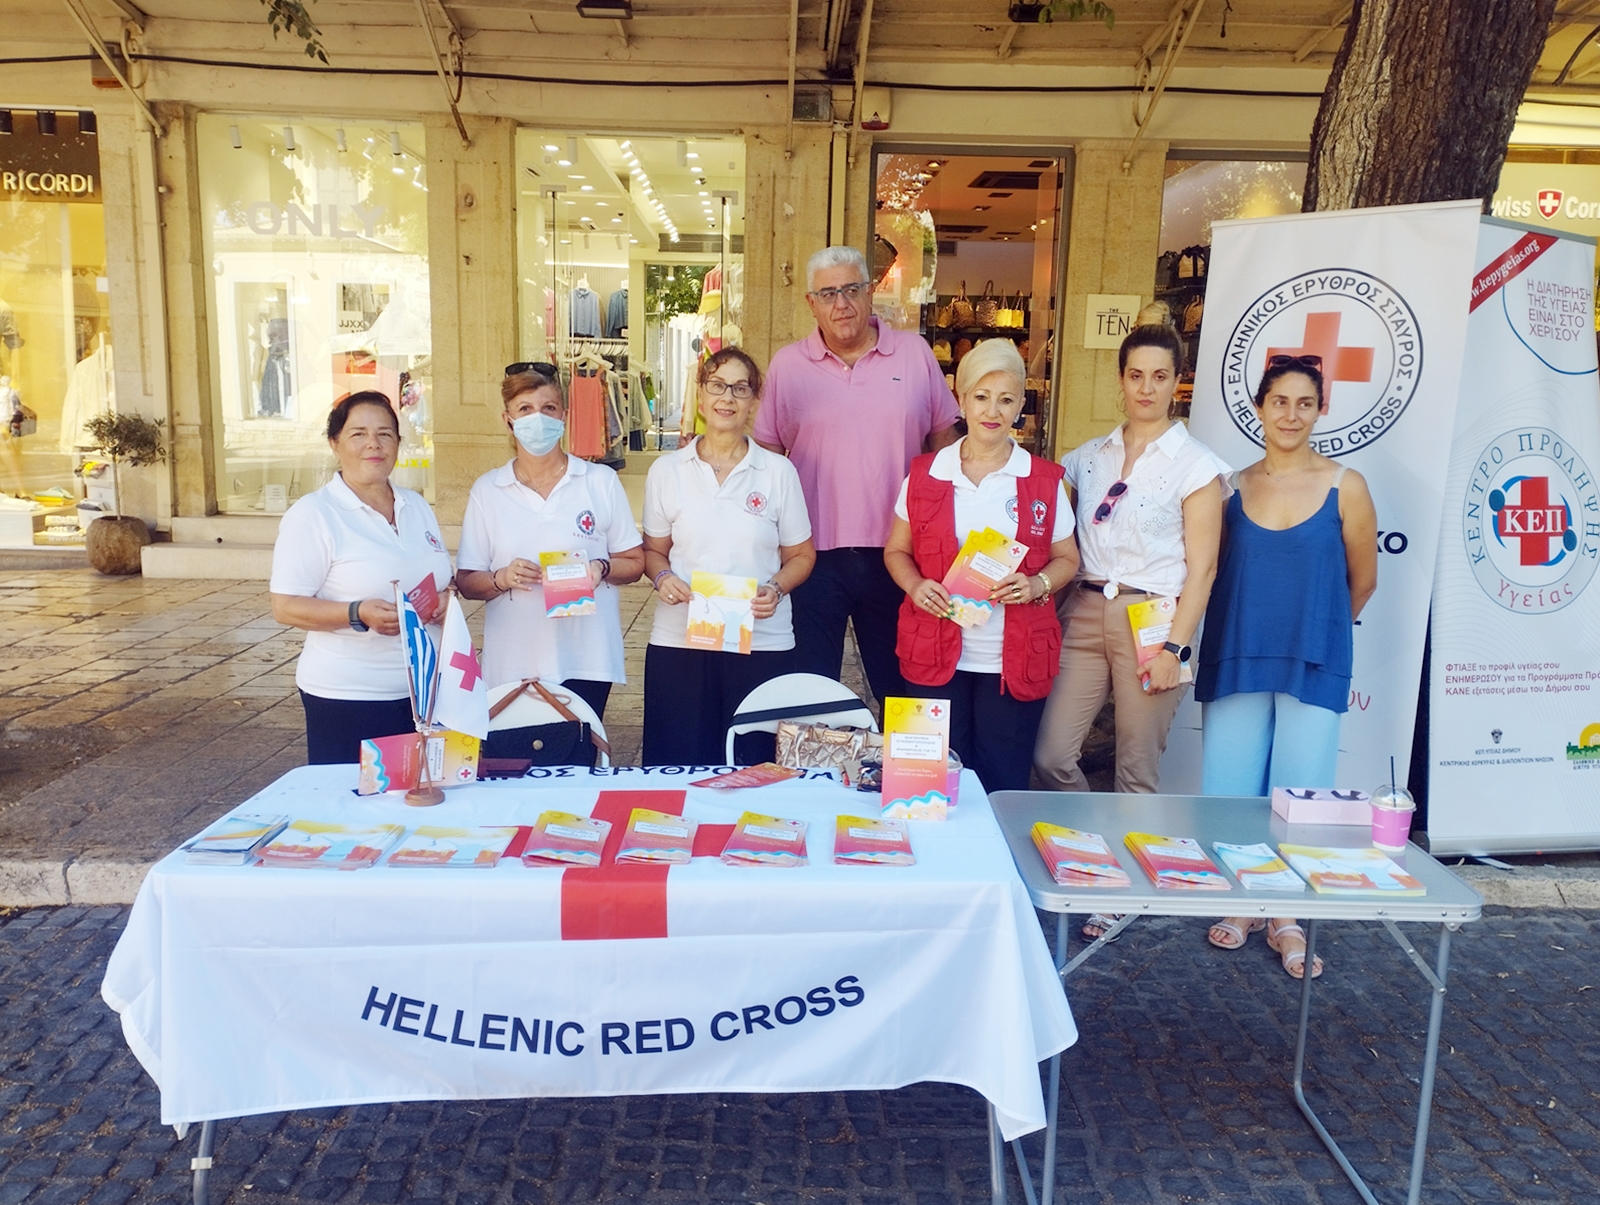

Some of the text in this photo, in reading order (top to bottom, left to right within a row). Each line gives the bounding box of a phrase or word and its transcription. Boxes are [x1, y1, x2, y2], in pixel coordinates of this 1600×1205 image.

[3, 171, 94, 193] RICORDI
[1491, 196, 1600, 219] wiss Cor
[247, 201, 386, 238] ONLY
[1471, 239, 1541, 299] w.kepygeias.org
[1526, 279, 1592, 302] Η ΔΙΑΤΗΡΗΣΗ
[1528, 293, 1588, 315] ΤΗΣ ΥΓΕΙΑΣ
[1096, 314, 1130, 336] TEN
[1228, 275, 1415, 385] ΕΛΛΗΝΙΚΟΣ ΕΡΥΘΡΟΣ ΣΤΑΥΡΟΣ
[1528, 308, 1585, 329] ΕΙΝΑΙ ΣΤΟ
[1529, 323, 1581, 342] ΧΕΡΙ ΣΟΥ
[1232, 399, 1267, 443] HELL
[1348, 396, 1402, 446] CROSS
[1467, 433, 1600, 564] ΚΕΝΤΡΟ ΠΡΟΛΗΨΗΣ
[1504, 508, 1564, 533] ΚΕΠ
[1498, 578, 1573, 609] Υγείας
[1446, 663, 1477, 672] ΦΤΙΑΞΕ
[1488, 662, 1516, 672] προφίλ
[1517, 661, 1542, 671] υγείας
[1446, 674, 1502, 684] ΕΝΗΜΕΡΩΣΟΥ
[1503, 675, 1515, 683] για
[1528, 673, 1583, 682] Προγράμματα
[1446, 687, 1470, 696] ΚΑΝΕ
[1472, 686, 1506, 696] εξετάσεις
[1507, 685, 1528, 695] μέσω
[1530, 685, 1544, 693] του
[1545, 684, 1572, 694] Δήμου
[589, 765, 738, 777] ΕΡΥΘΡΟ
[360, 974, 866, 1057] HELLENIC RED CROSS
